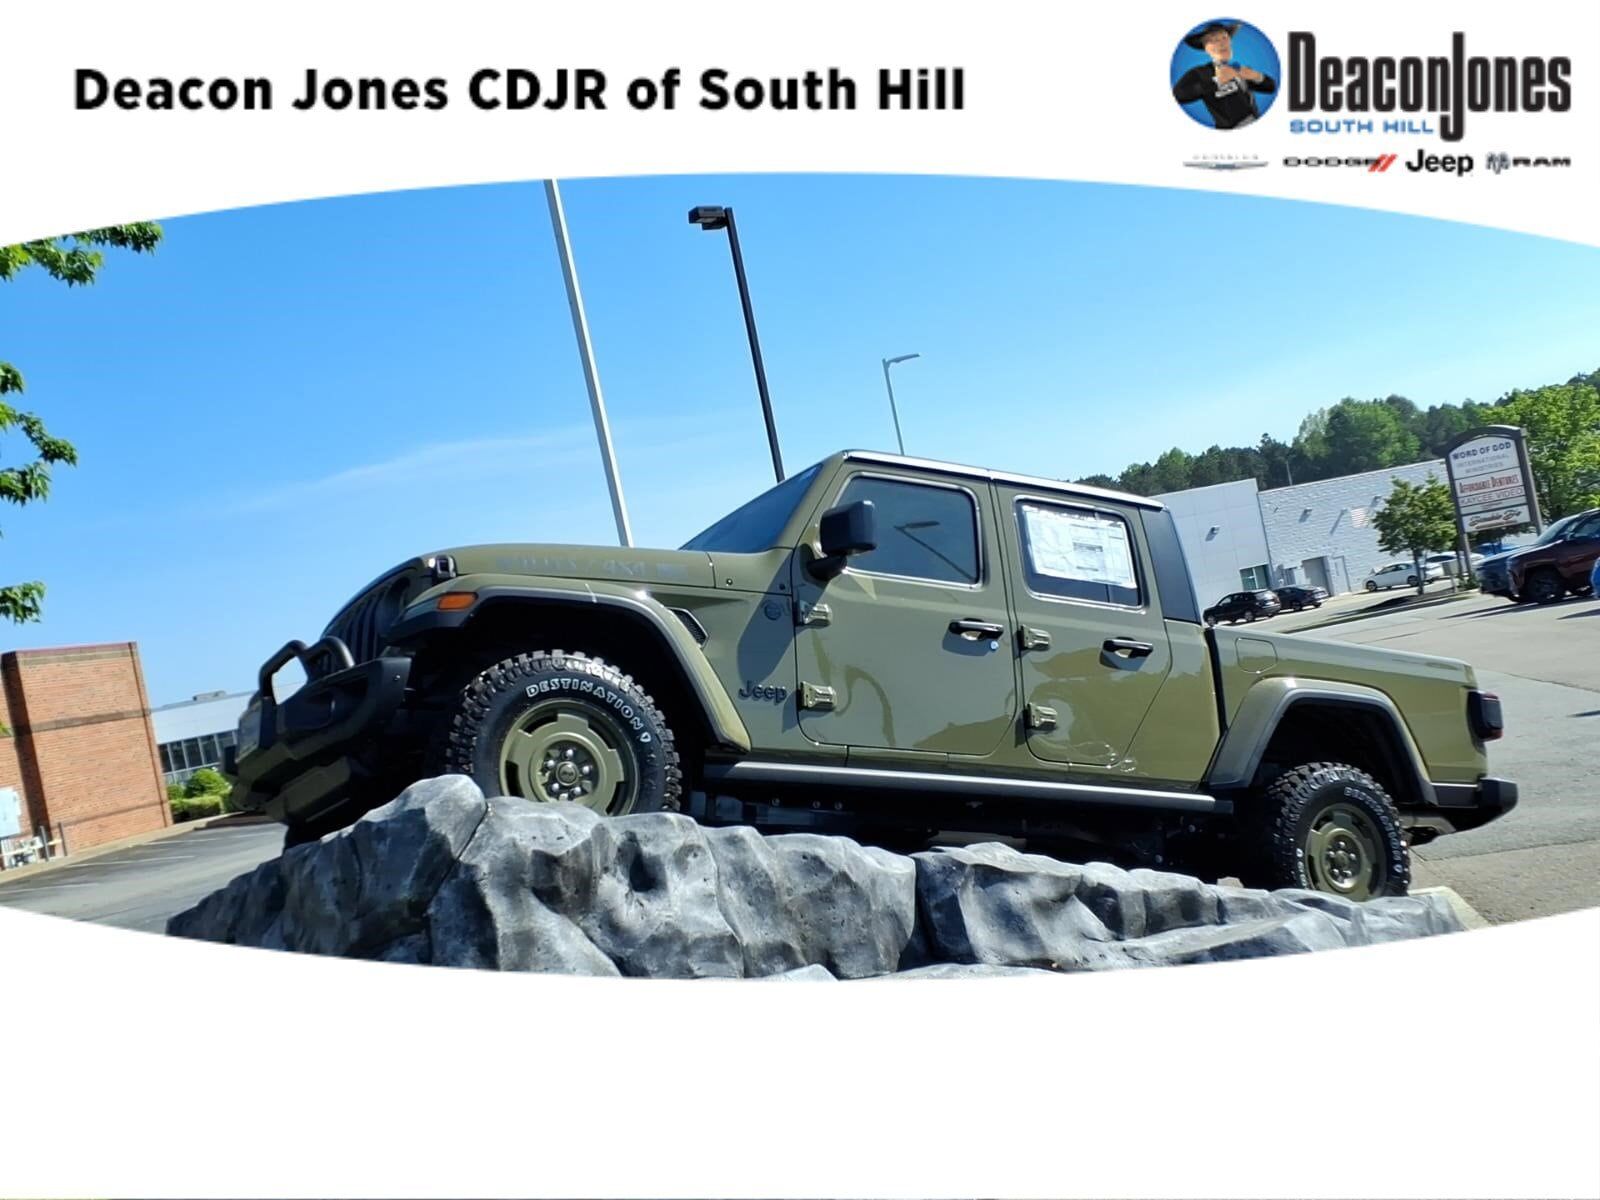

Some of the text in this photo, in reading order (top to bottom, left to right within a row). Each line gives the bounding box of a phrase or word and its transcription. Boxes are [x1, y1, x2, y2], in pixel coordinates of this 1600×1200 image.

[1452, 449, 1478, 460] WORD
[1479, 446, 1491, 455] OF
[526, 678, 644, 730] DESTINATION
[738, 680, 787, 704] Jeep
